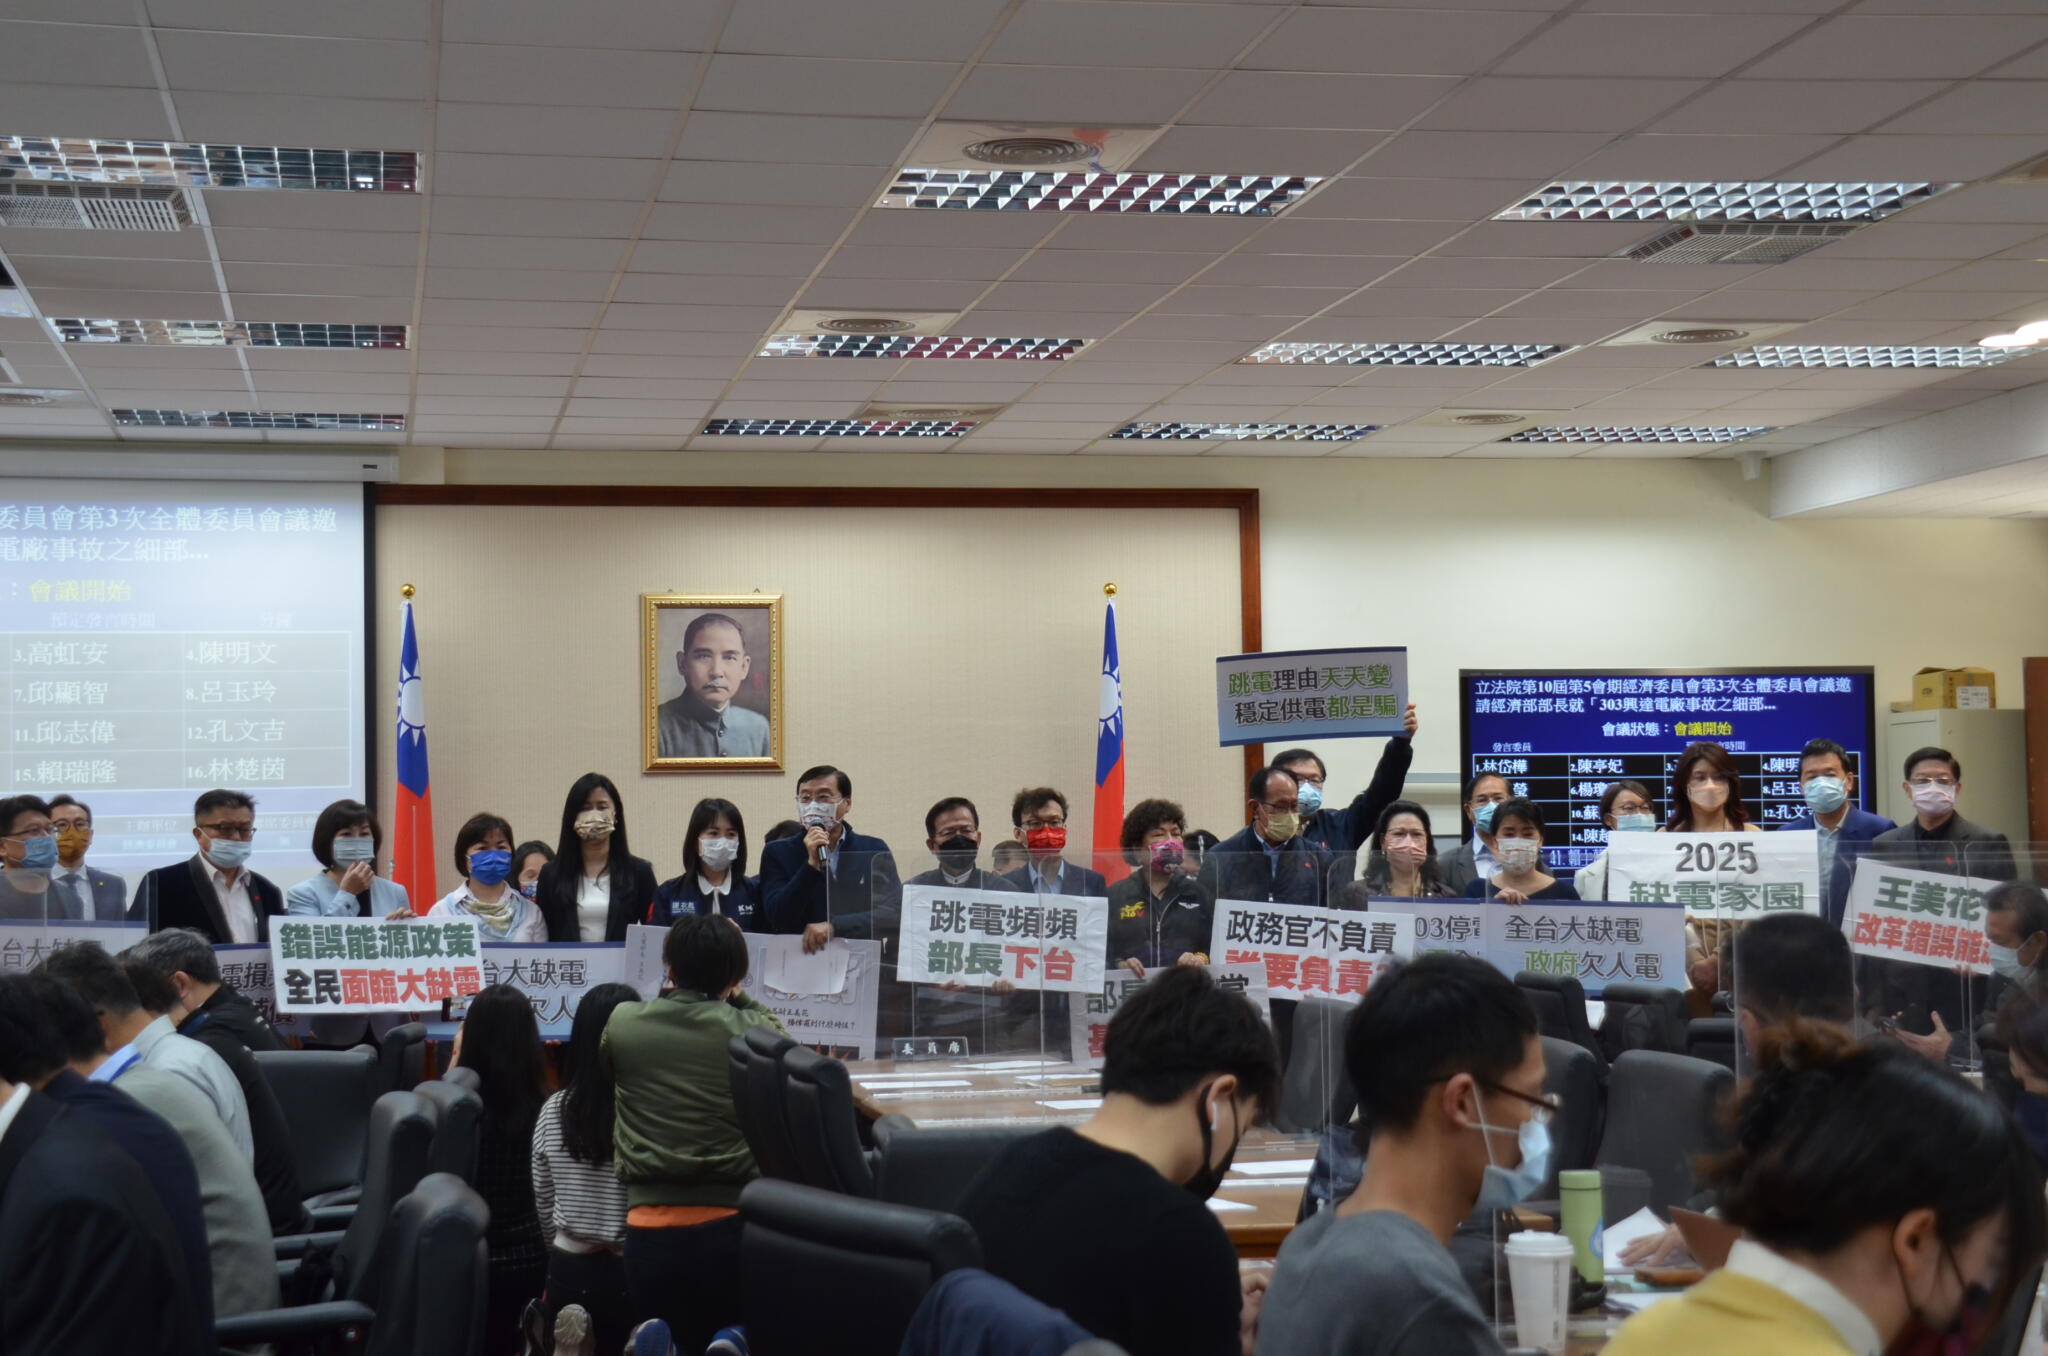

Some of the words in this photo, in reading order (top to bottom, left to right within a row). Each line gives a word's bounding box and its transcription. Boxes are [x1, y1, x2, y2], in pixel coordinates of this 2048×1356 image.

[0, 506, 337, 532] 委員會第3次全體委員會議邀
[1228, 664, 1392, 698] 跳電理由天天變
[1235, 694, 1399, 727] 穩定供電都是騙
[1676, 842, 1758, 875] 2025
[1629, 881, 1804, 912] 缺電家園
[1874, 876, 1987, 921] 王美花
[929, 900, 1078, 940] 跳電頻頻
[1225, 910, 1397, 953] 政務官不負責
[1504, 914, 1643, 943] 全台大缺電
[280, 923, 477, 959] 錯誤能源政策
[927, 940, 1076, 981] 部長下台
[1524, 949, 1662, 980] 政府欠人電
[283, 966, 481, 1005] 全民面臨大缺電
